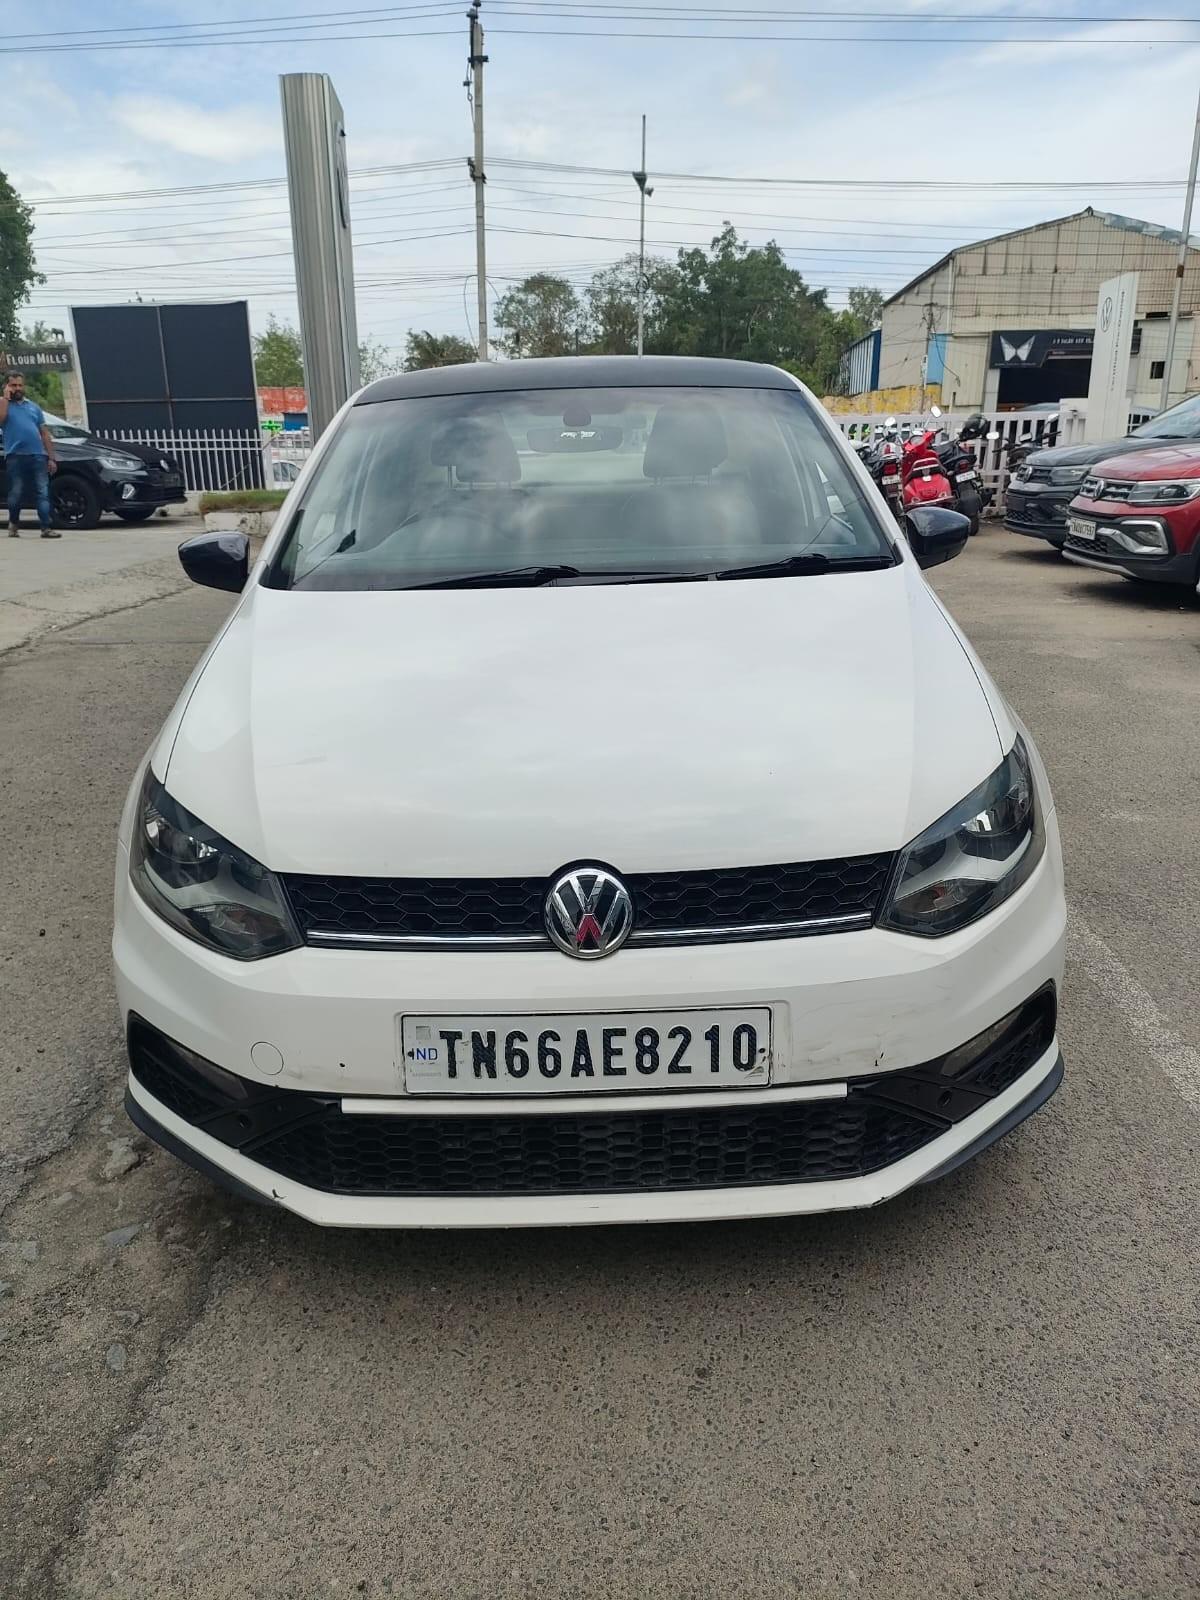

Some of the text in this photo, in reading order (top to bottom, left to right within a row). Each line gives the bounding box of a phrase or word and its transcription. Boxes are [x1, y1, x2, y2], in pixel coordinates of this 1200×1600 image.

[6, 352, 68, 365] FLOUR MILLS
[438, 1022, 758, 1079] TN66AE8210
